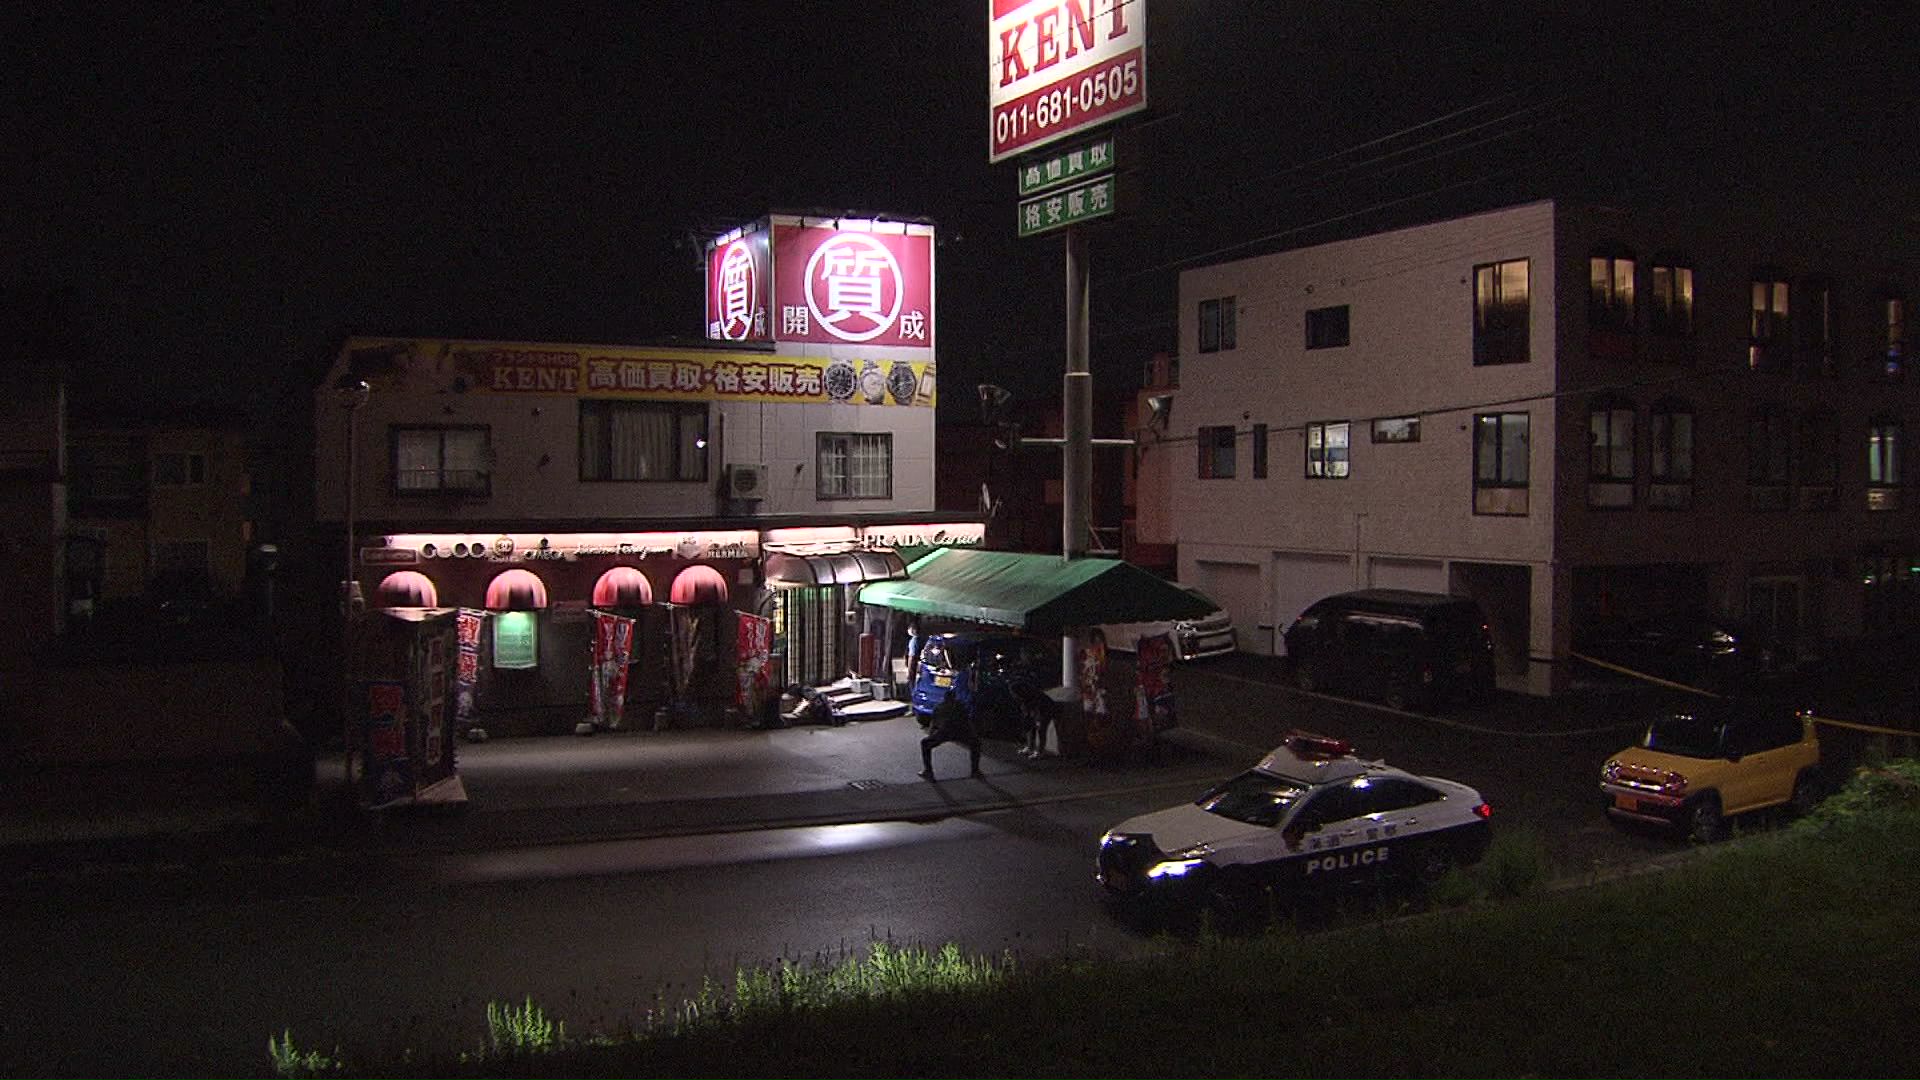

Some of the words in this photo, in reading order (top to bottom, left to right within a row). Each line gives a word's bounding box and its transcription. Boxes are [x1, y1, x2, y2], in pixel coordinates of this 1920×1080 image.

[999, 0, 1129, 87] KENT
[996, 59, 1138, 144] 011-681-0505
[1025, 183, 1108, 229] 格安販売
[821, 247, 890, 325] 質
[783, 305, 809, 335] 開
[899, 311, 925, 340] 成
[493, 366, 579, 391] KENT
[588, 359, 823, 395] 高価買取・格安販売
[863, 533, 930, 548] PRADA
[1305, 846, 1390, 876] POLICE
